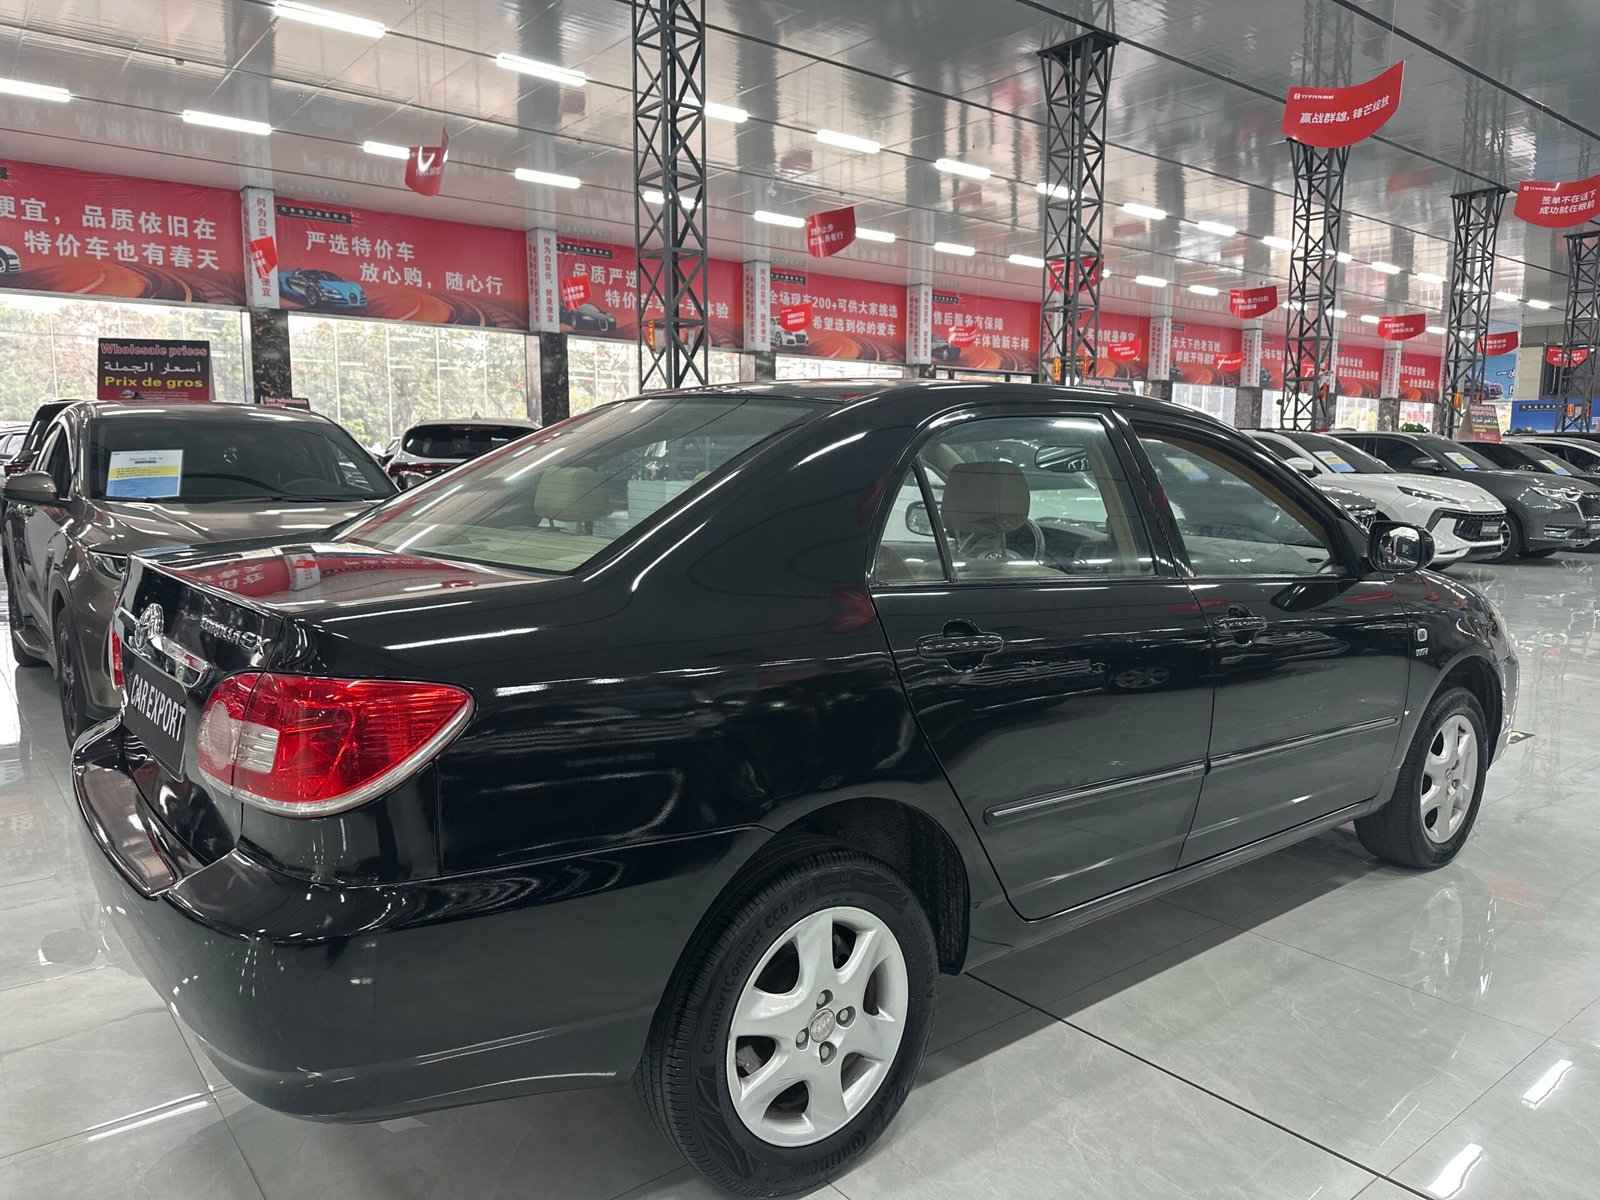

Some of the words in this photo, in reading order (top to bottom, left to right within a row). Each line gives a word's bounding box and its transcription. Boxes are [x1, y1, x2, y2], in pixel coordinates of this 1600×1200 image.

[1541, 189, 1597, 205] 签单不在话下
[1539, 200, 1595, 215] 成功就在眼前
[0, 195, 217, 241] 便宜，品质依旧在
[24, 229, 220, 271] 特价车也有春天
[305, 230, 415, 261] 严选特价车
[359, 263, 504, 295] 放心购，随心行
[812, 315, 896, 337] 希望选到你的爱车
[933, 310, 1004, 331] 售后服务有保障
[100, 342, 167, 356] Wholesale
[168, 345, 208, 358] prices
[1170, 336, 1222, 352] 全天下的老百姓
[104, 362, 154, 374] الجملة
[160, 361, 201, 375] أسعار
[104, 376, 137, 387] Prix
[142, 377, 162, 387] de
[166, 379, 203, 389] gros
[702, 928, 764, 1055] ComfortContact
[765, 902, 790, 929] CC6
